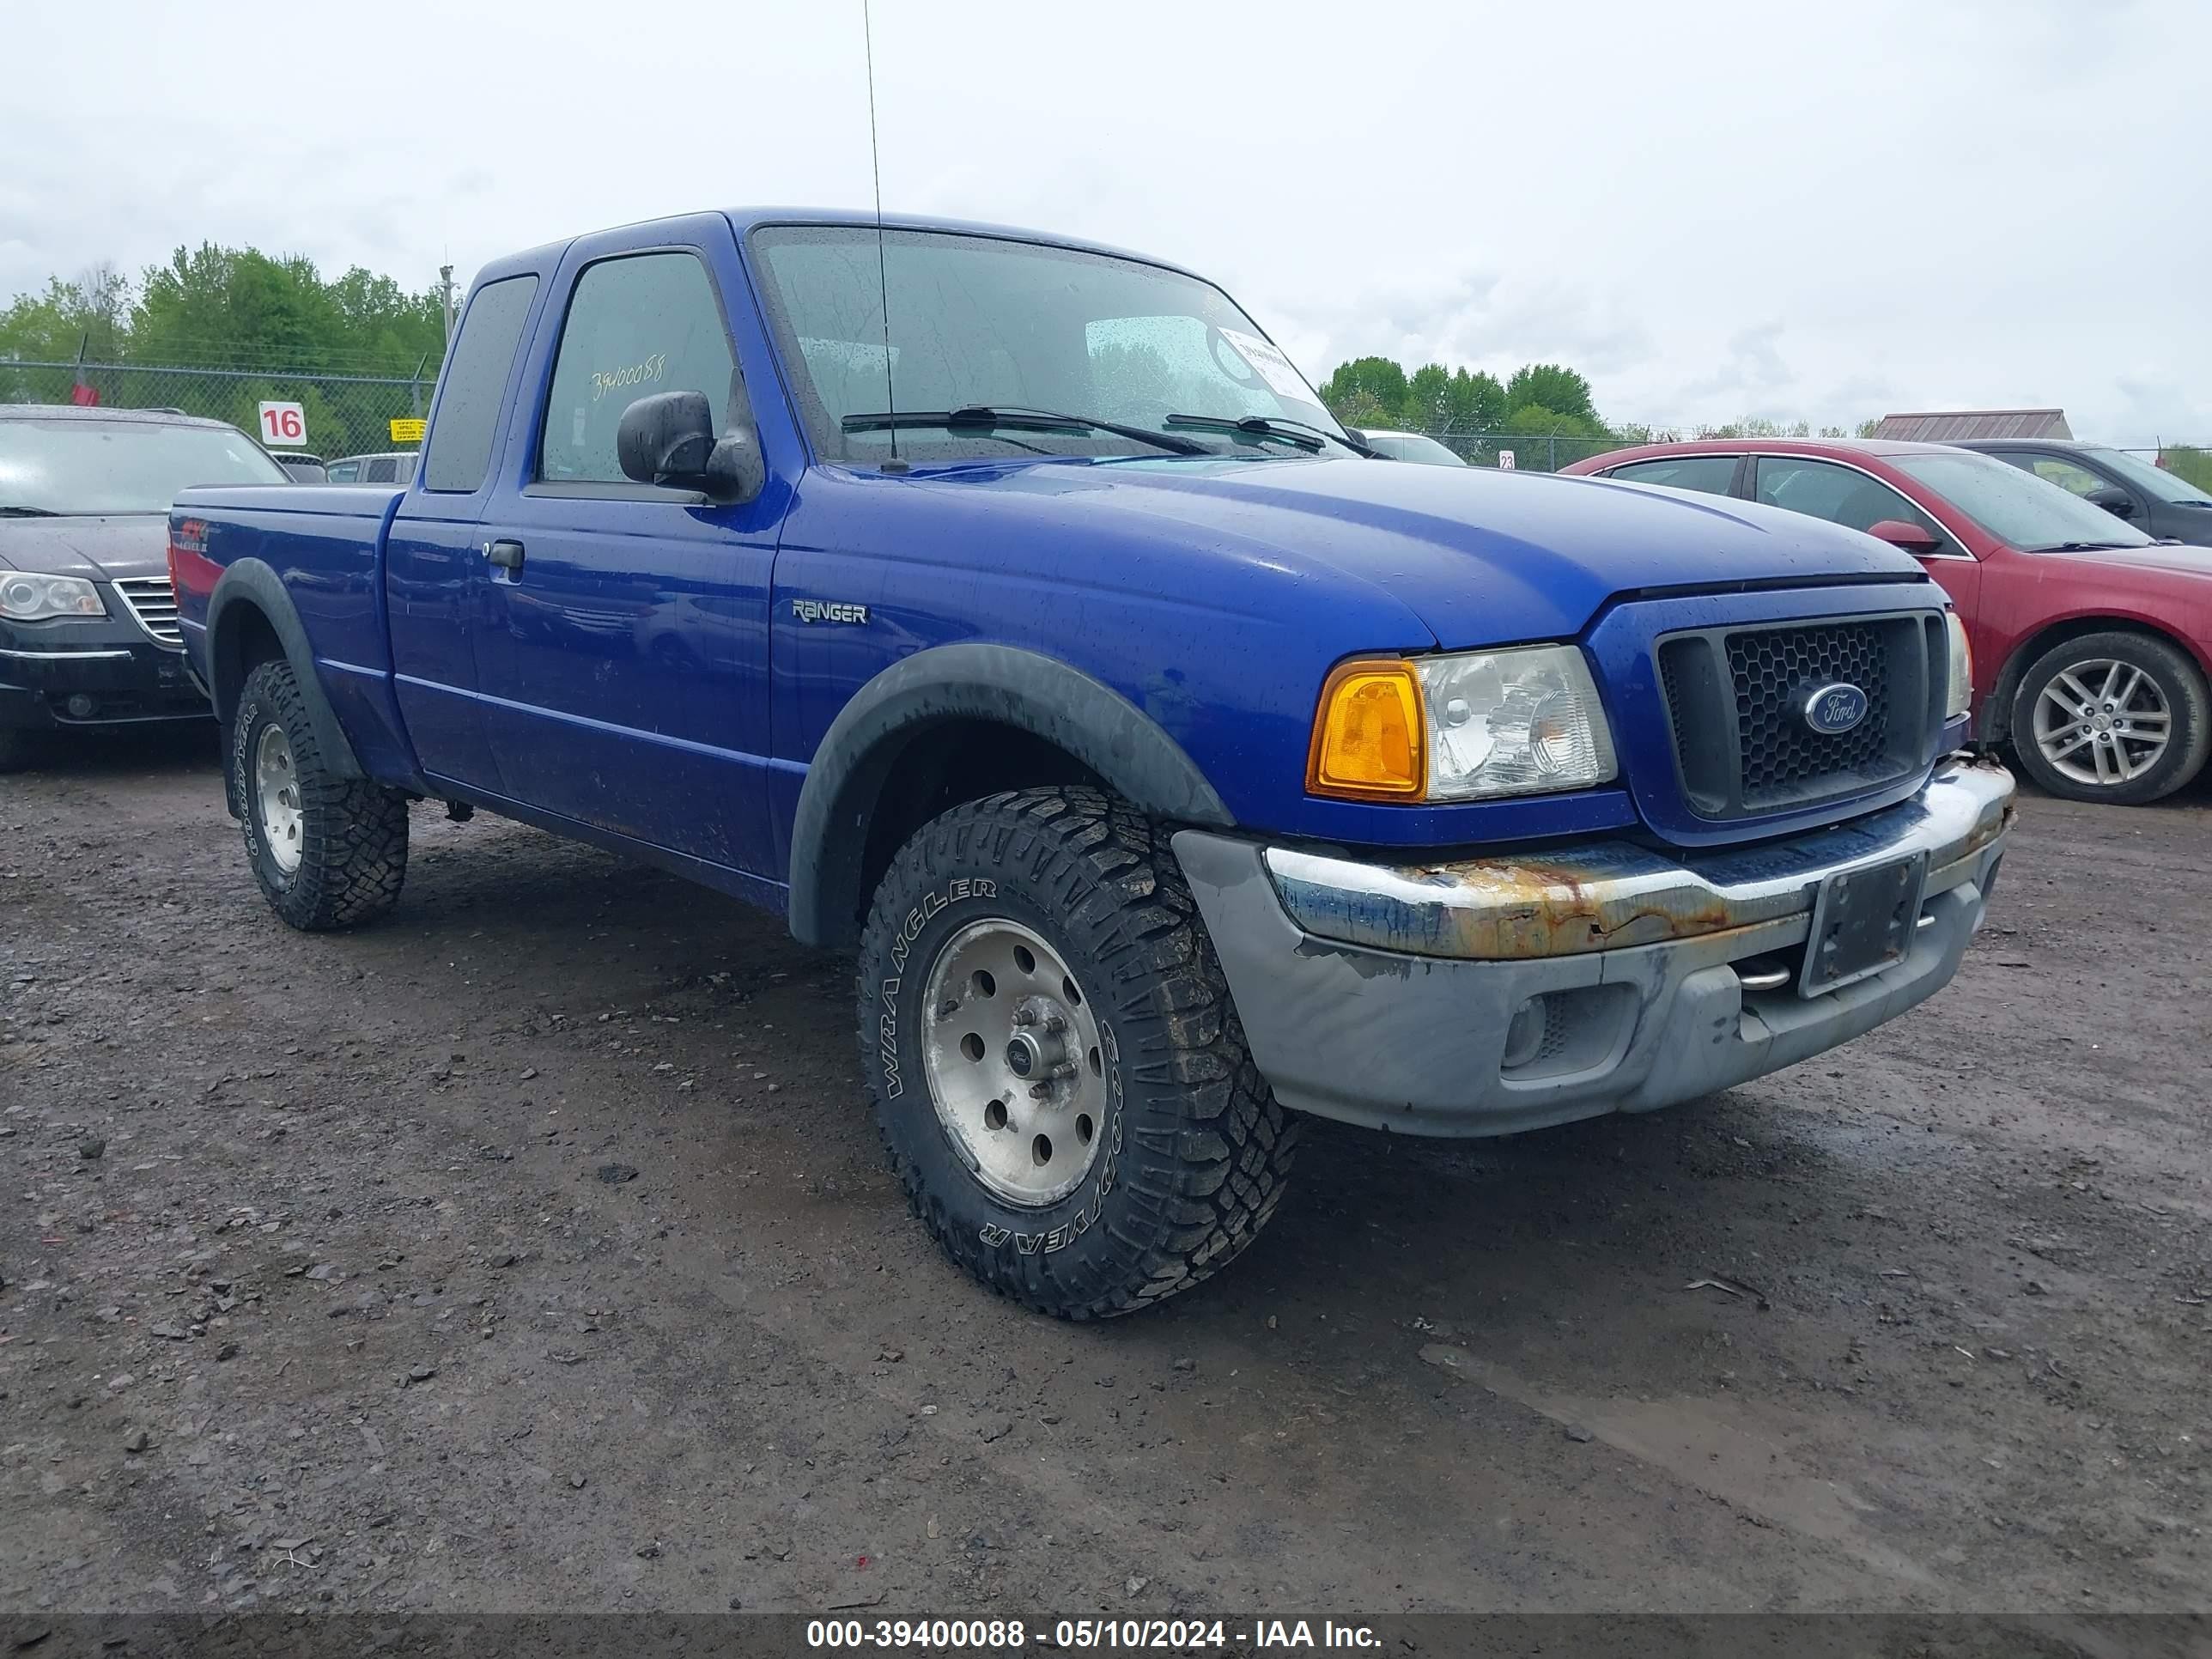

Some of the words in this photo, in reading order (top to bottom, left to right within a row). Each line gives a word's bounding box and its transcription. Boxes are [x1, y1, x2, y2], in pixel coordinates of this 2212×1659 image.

[592, 353, 666, 402] 39400088
[264, 410, 301, 438] 16
[1502, 455, 1513, 469] 23
[792, 599, 867, 624] RANGER
[1825, 694, 1856, 723] Ford
[879, 878, 998, 1099] WRANGLER
[979, 1019, 1125, 1255] GOODYEAR
